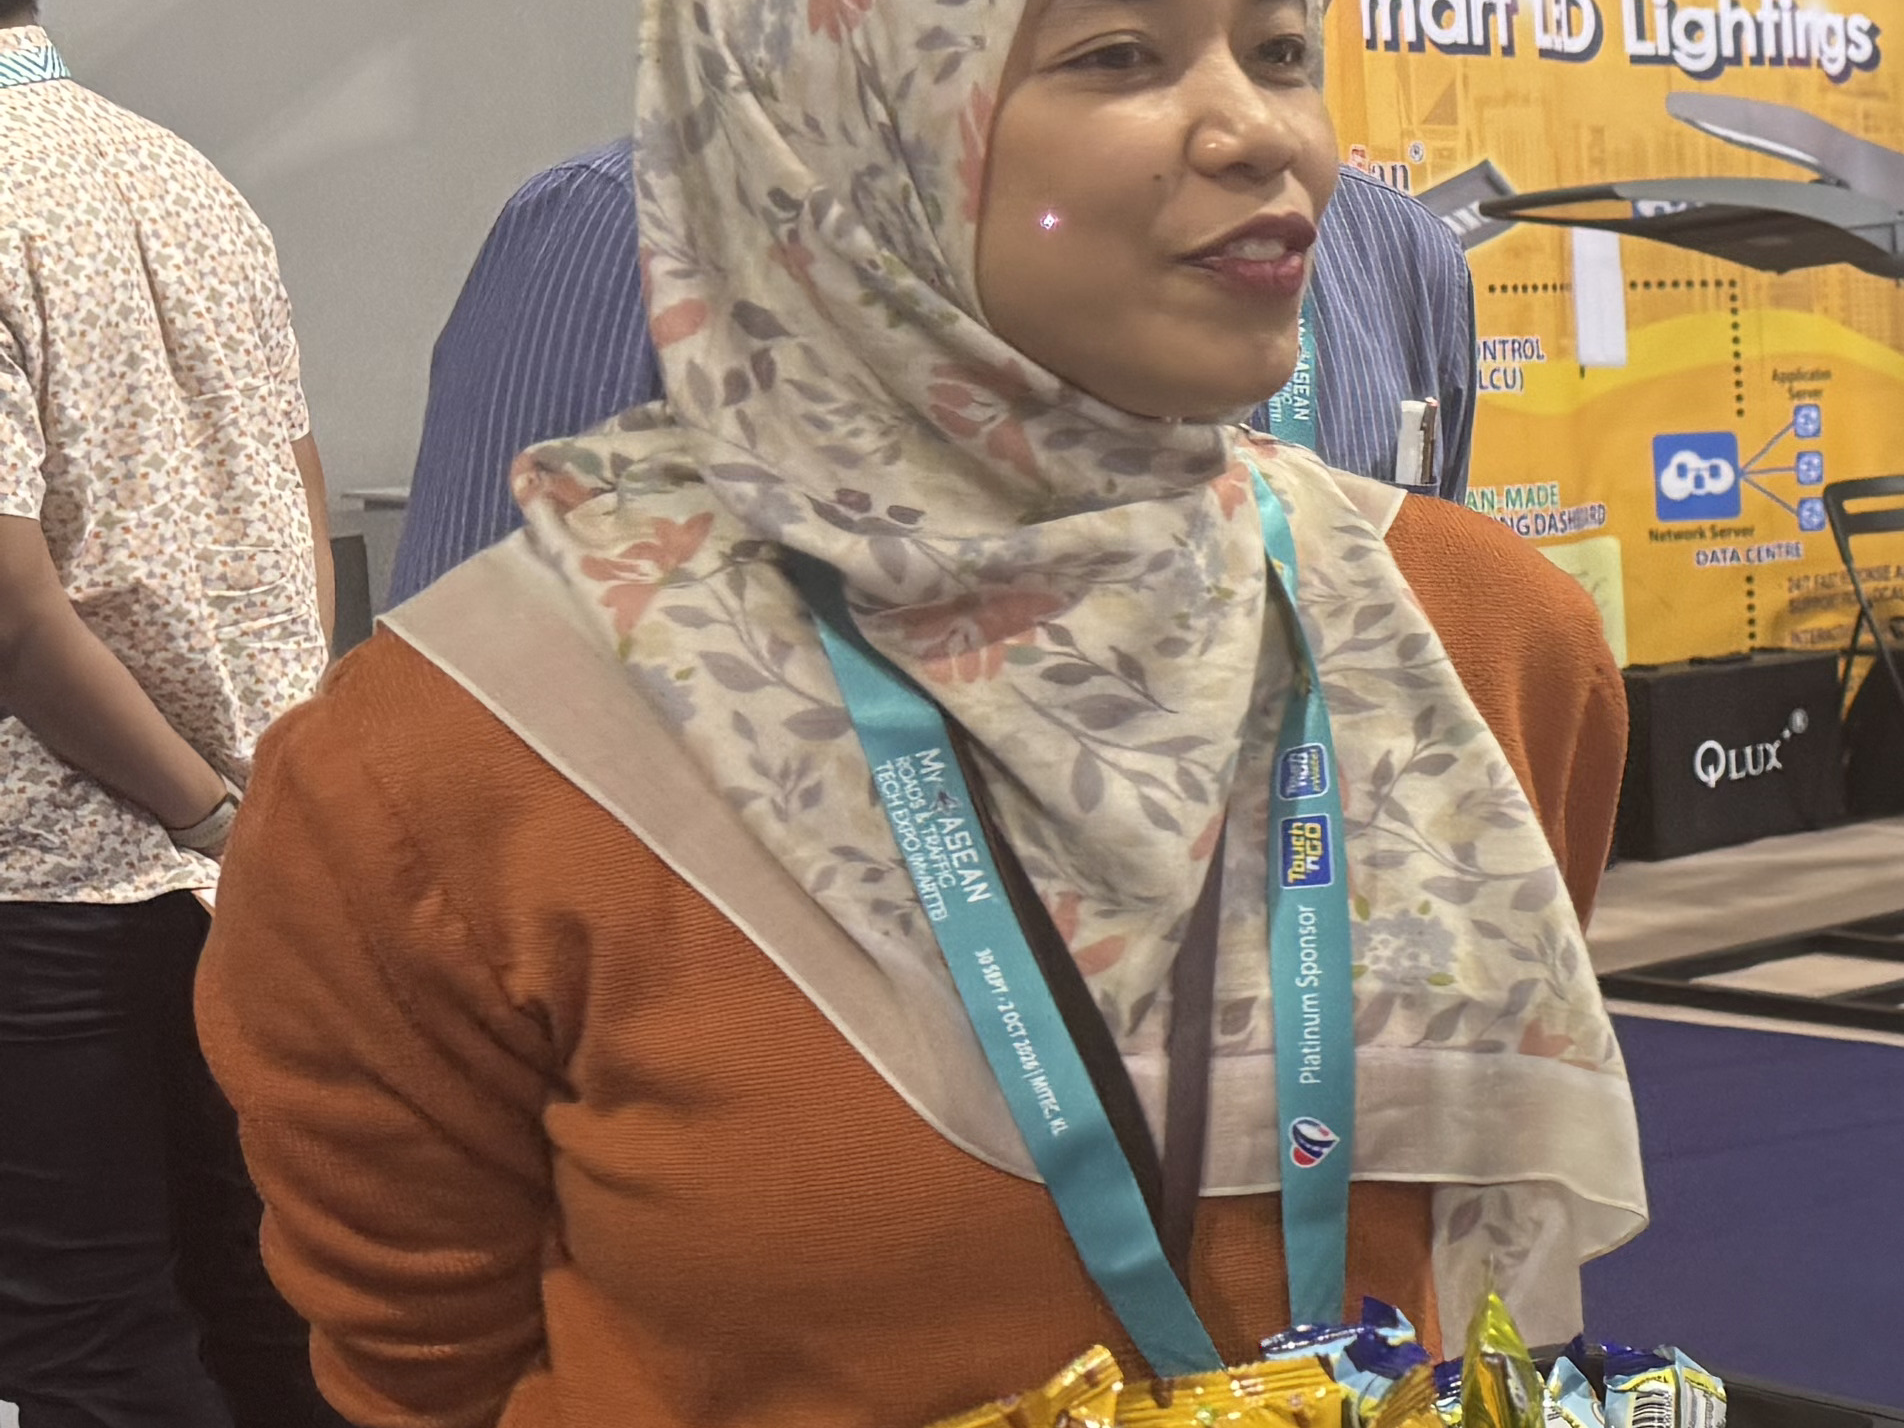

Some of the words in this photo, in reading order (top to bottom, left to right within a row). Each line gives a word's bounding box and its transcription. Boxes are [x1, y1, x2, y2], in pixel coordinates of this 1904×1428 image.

[1476, 338, 1545, 361] NTROL
[1479, 368, 1524, 391] LCU)
[1696, 546, 1742, 566] DATA
[1746, 541, 1804, 563] CENTRE
[1694, 740, 1783, 789] QLUX
[874, 759, 902, 809] TECH
[891, 809, 921, 853] EXPO
[896, 755, 926, 809] ROADS
[920, 823, 956, 889] TRAFFIC
[938, 816, 993, 904] ASEAN
[1288, 822, 1307, 884] Touch
[1295, 904, 1323, 988] Sponsor
[981, 963, 1008, 995] SEPT
[1001, 1011, 1027, 1039] OCT
[1298, 992, 1322, 1085] Platinum
